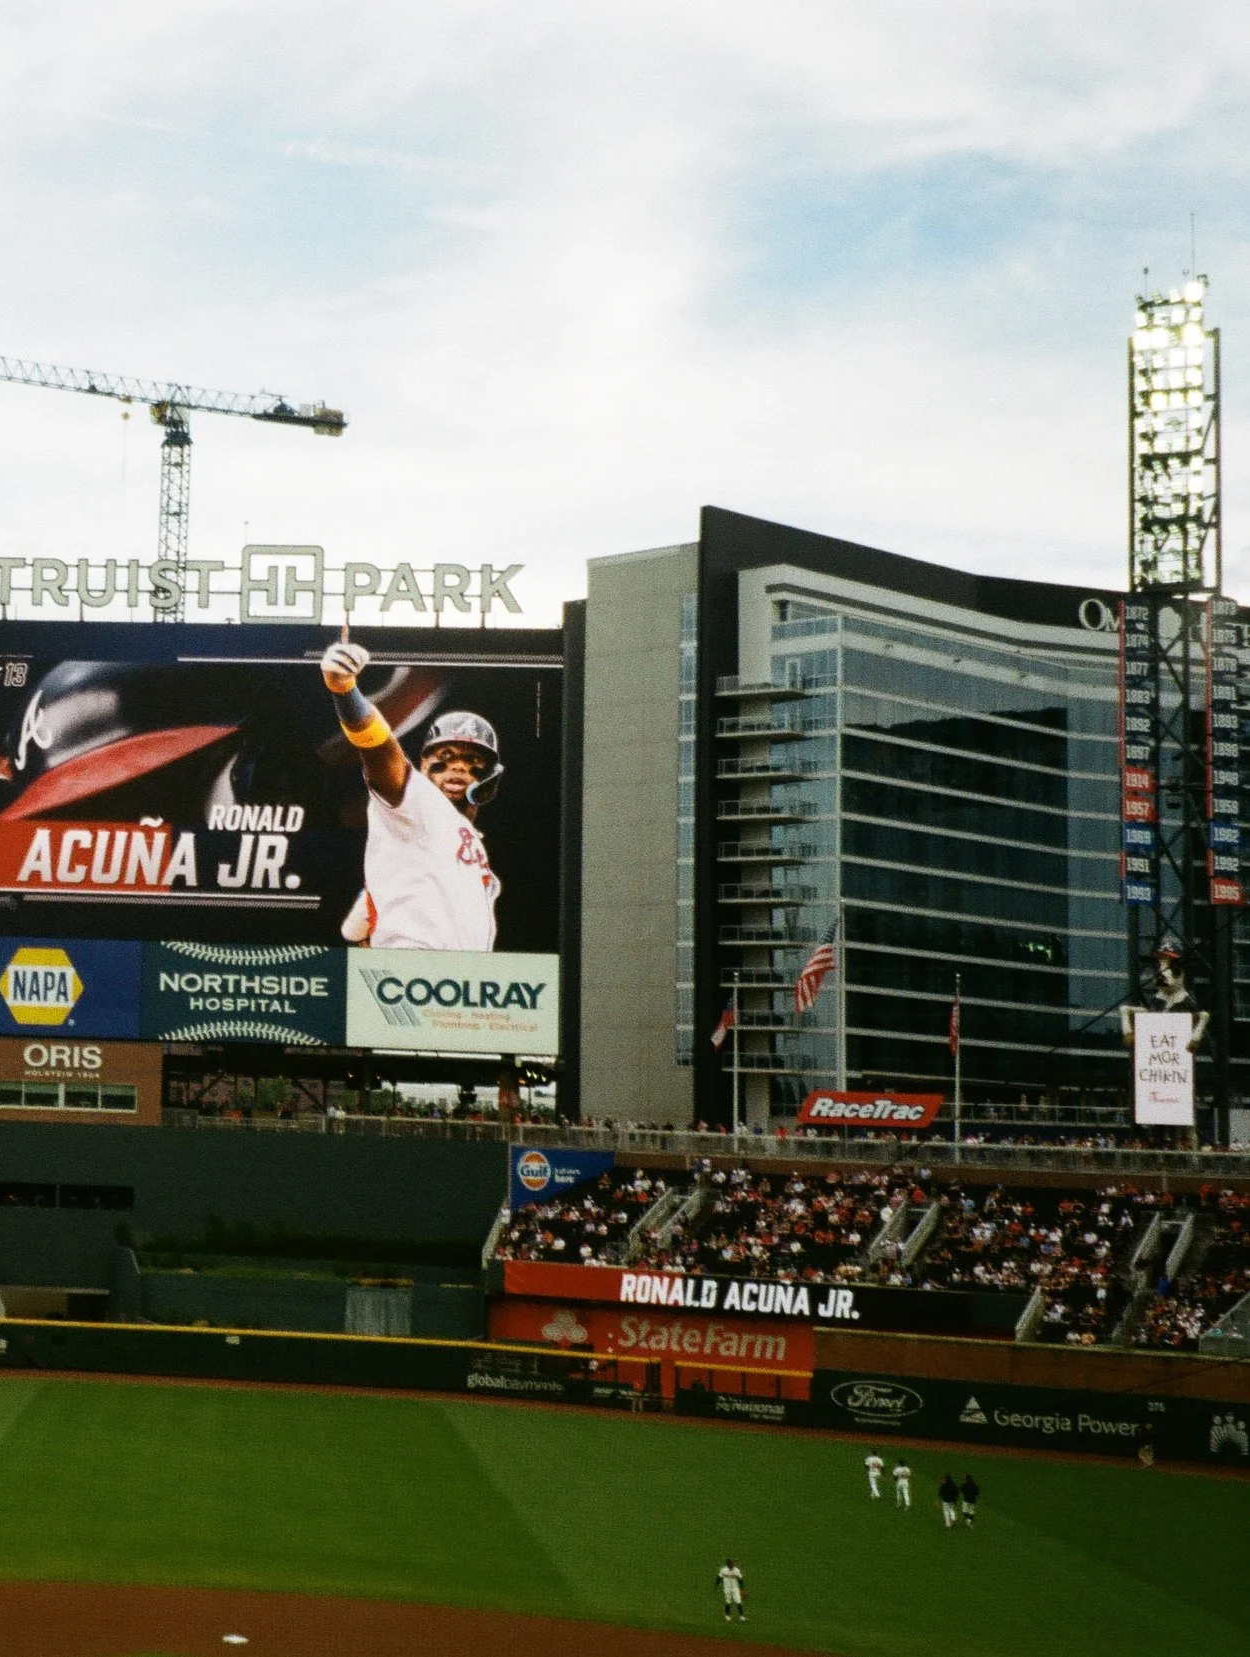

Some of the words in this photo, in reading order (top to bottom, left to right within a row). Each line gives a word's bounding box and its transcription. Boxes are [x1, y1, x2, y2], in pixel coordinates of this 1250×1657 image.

[344, 562, 525, 615] PARK
[3, 662, 29, 687] 13
[209, 804, 304, 833] RONALD
[1125, 800, 1151, 817] 1957
[18, 816, 200, 888] ACUÑA
[217, 832, 302, 890] JR.
[11, 970, 69, 1002] NAPA
[159, 972, 329, 998] NORTHSIDE
[376, 976, 547, 1010] COOLRAY
[190, 998, 296, 1015] HOSPITAL
[1150, 1034, 1178, 1049] EAT
[23, 1043, 103, 1070] ORIS
[1148, 1051, 1180, 1067] MOR
[810, 1097, 925, 1120] RaceTrac
[521, 1165, 548, 1177] Gulf
[620, 1272, 720, 1309] RONALD
[818, 1288, 860, 1320] JR.
[847, 1384, 908, 1408] Ford
[993, 1409, 1072, 1434] Georgia
[1077, 1414, 1141, 1436] Power
